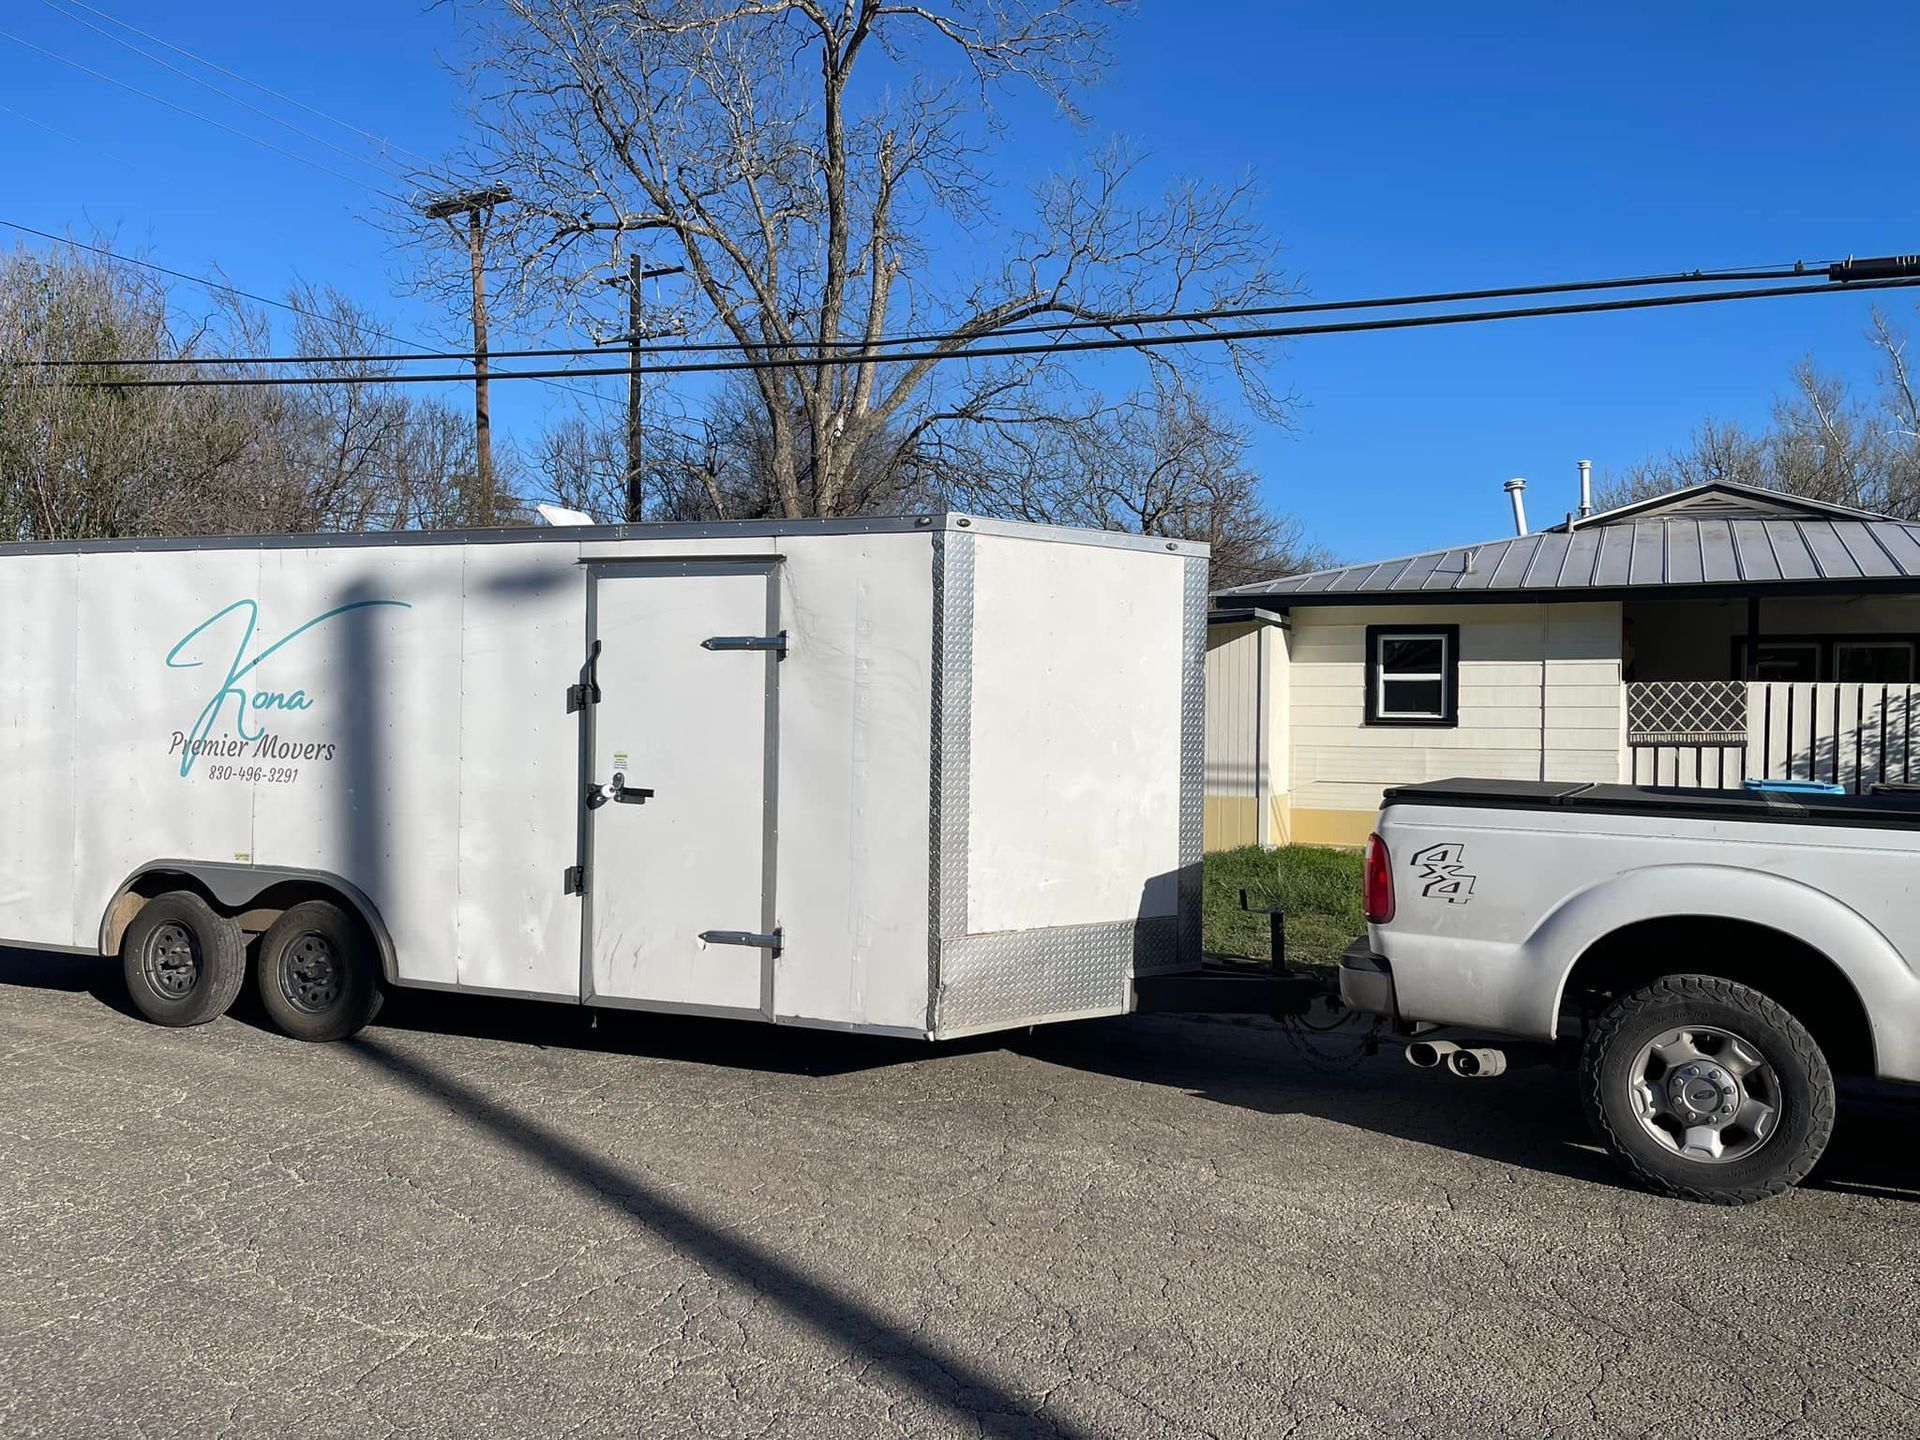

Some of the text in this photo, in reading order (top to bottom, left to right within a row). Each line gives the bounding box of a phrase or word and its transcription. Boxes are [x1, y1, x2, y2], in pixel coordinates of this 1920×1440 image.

[166, 598, 412, 778] Kona
[168, 731, 337, 761] Premier Movers
[208, 765, 299, 784] 830-496-3291
